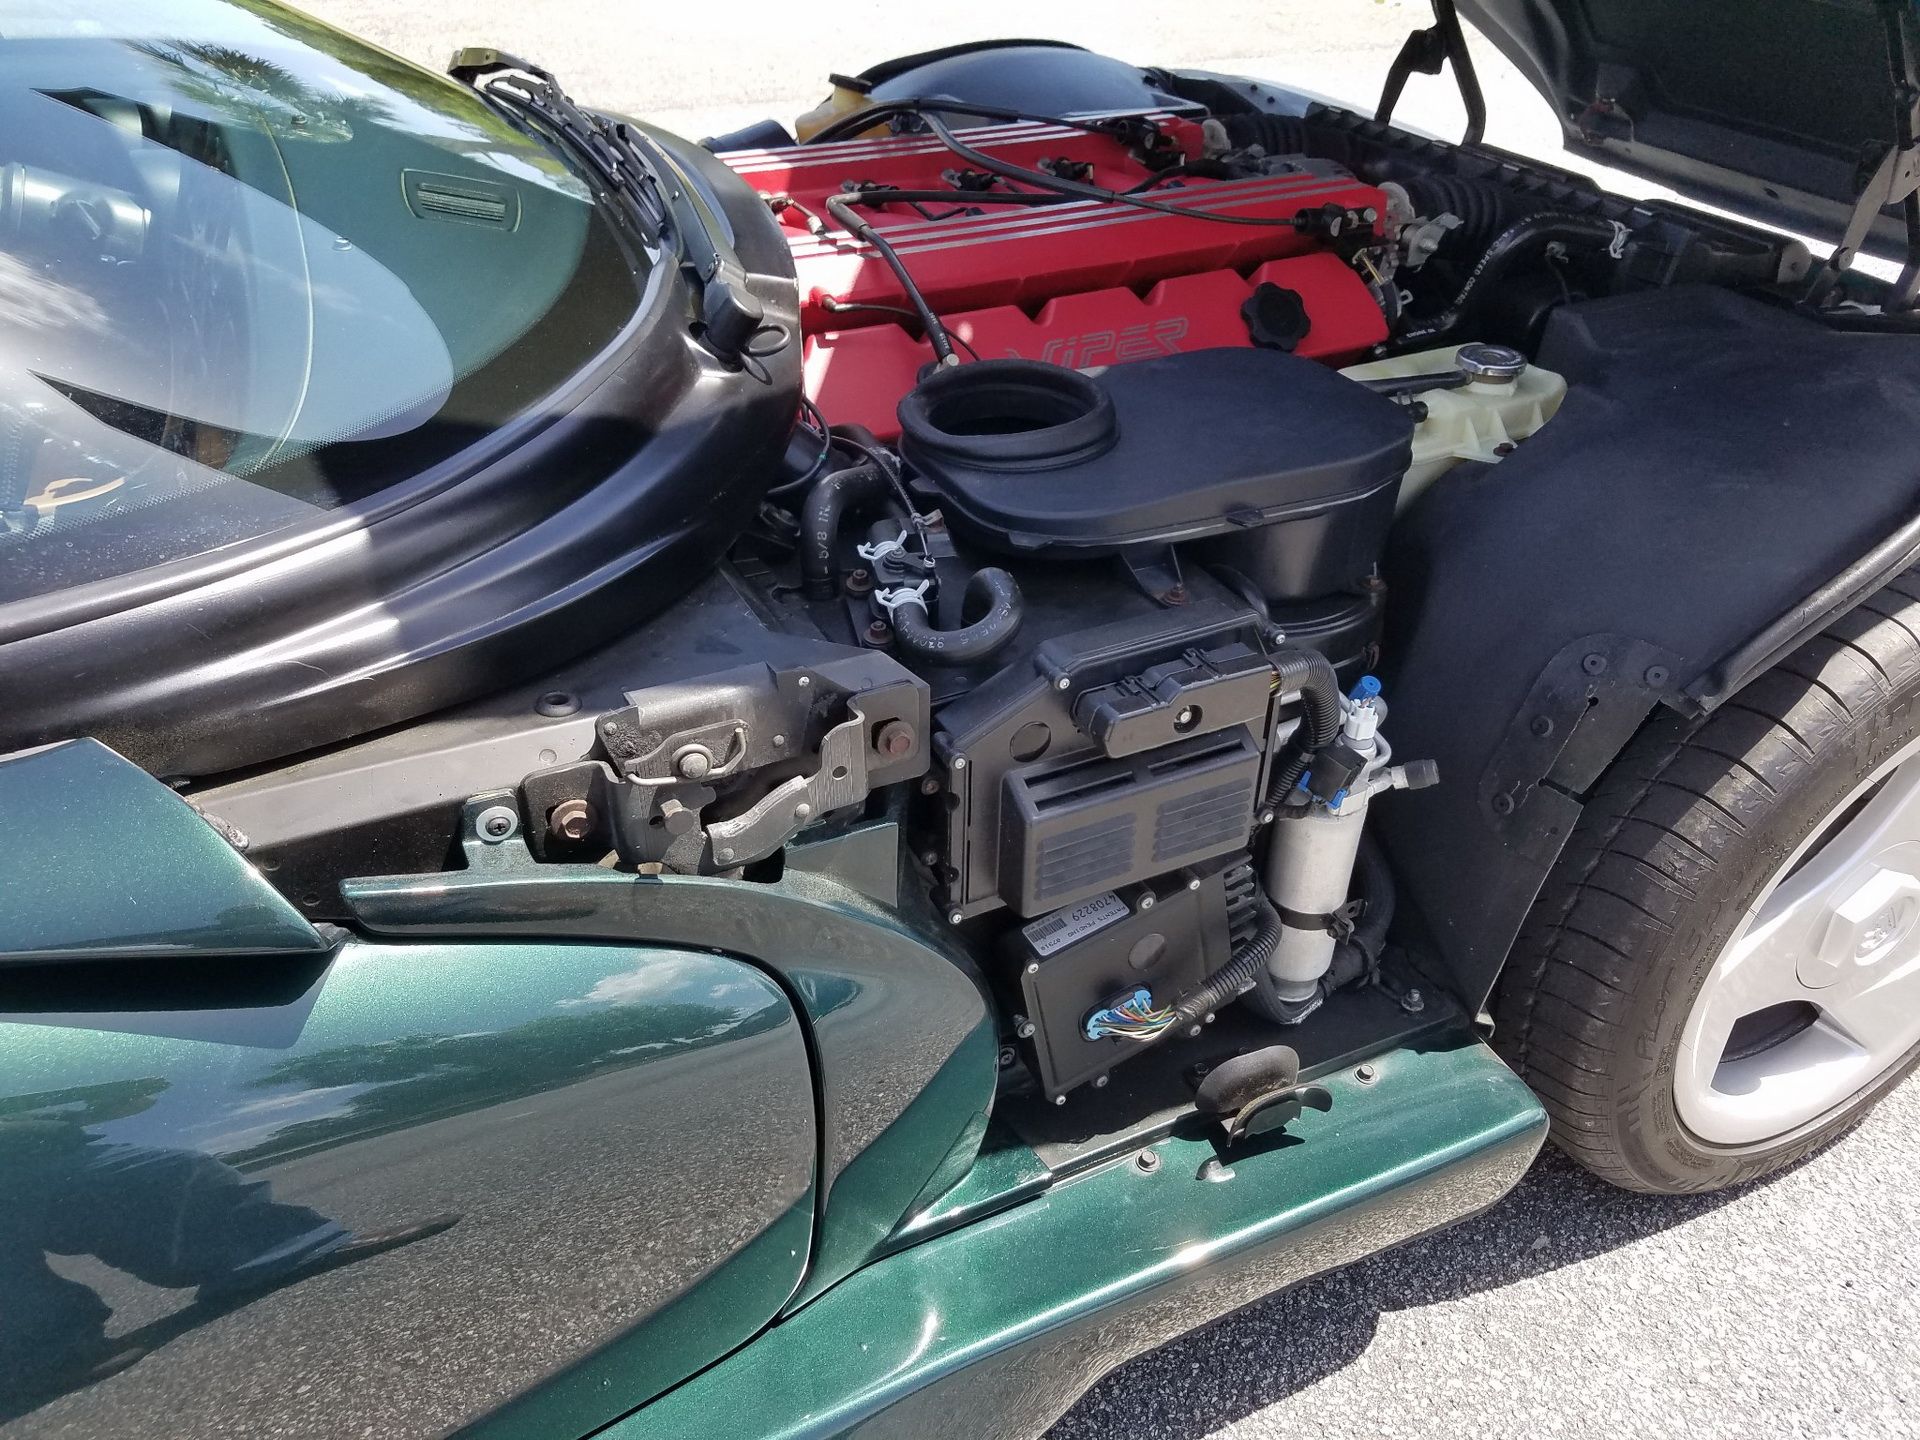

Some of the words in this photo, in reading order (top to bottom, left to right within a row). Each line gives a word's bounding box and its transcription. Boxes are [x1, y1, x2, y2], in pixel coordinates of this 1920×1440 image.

[1474, 248, 1494, 276] SPEED
[1071, 893, 1117, 922] 4708229
[1097, 905, 1126, 922] PATENTS
[1067, 920, 1097, 938] PENDING
